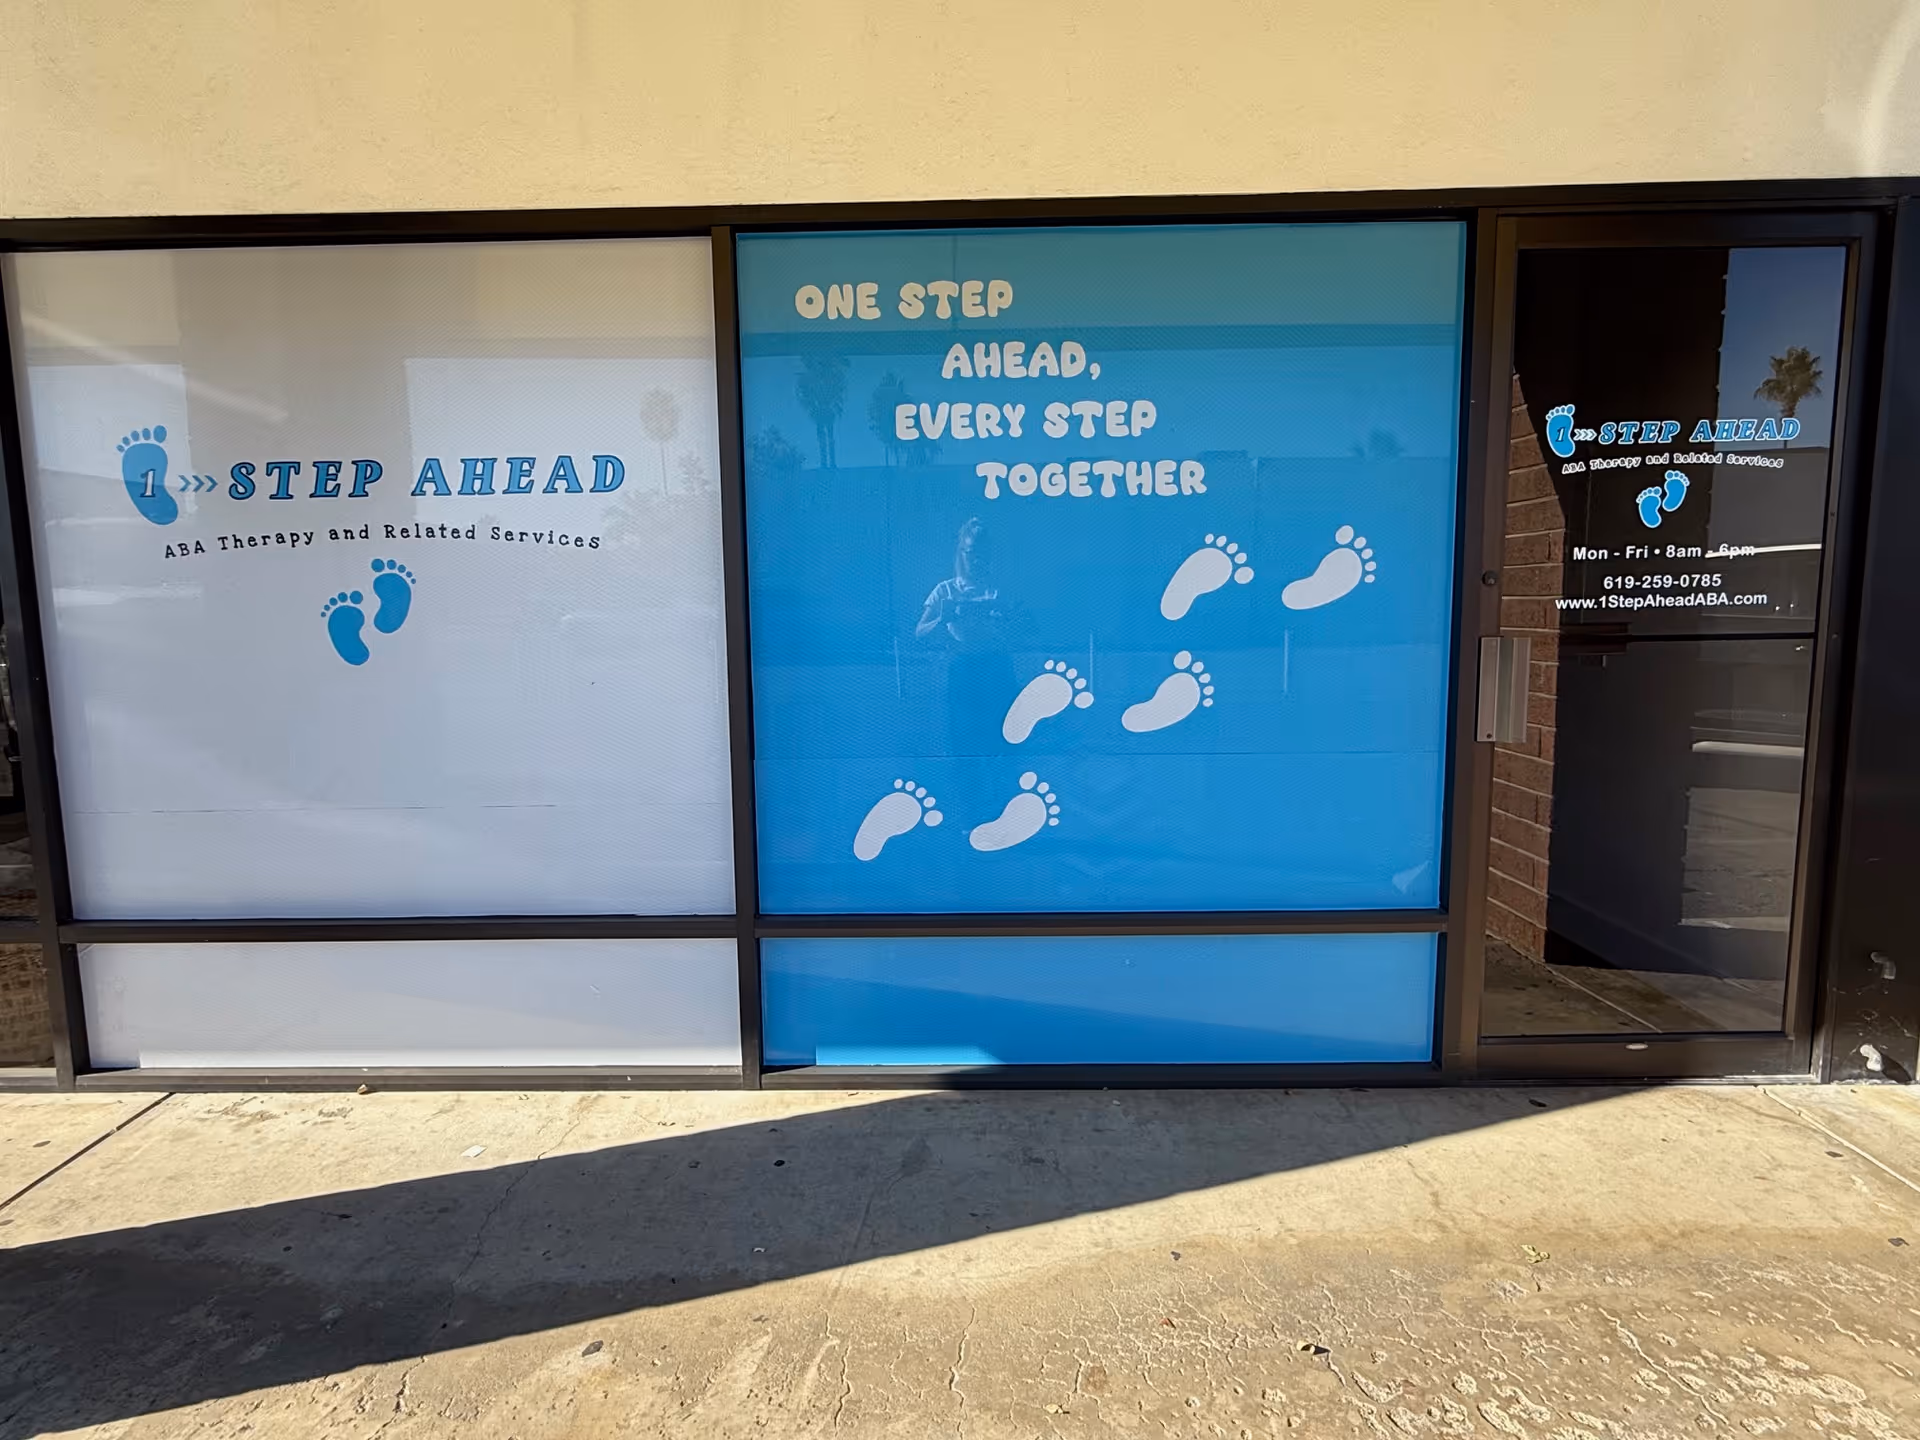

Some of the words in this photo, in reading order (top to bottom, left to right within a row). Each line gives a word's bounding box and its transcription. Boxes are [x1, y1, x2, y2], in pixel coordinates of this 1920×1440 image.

[795, 282, 880, 320] ONE
[898, 280, 1013, 319] STEP
[941, 341, 1101, 380] AHEAD,
[895, 402, 1026, 441] EVERY
[1043, 400, 1157, 438] STEP
[1555, 426, 1566, 443] 1
[1598, 421, 1681, 445] STEP
[1690, 418, 1801, 443] AHEAD
[139, 468, 158, 498] 1
[228, 459, 384, 501] STEP
[411, 454, 627, 497] AHEAD
[976, 460, 1207, 499] TOGETHER
[1562, 462, 1586, 474] ABA
[1590, 456, 1641, 470] Therapy
[1646, 453, 1669, 466] and
[1673, 452, 1722, 465] Related
[1726, 453, 1784, 469] Services
[164, 538, 207, 560] ABA
[218, 528, 315, 552] Therapy
[329, 523, 370, 542] and
[383, 522, 477, 541] Related
[490, 526, 602, 551] Services
[1573, 547, 1608, 561] Mon
[1626, 545, 1648, 560] Fri
[1665, 545, 1701, 559] 8am
[1719, 543, 1755, 560] 6pm
[1603, 573, 1722, 590] 619-259-0785
[1555, 592, 1768, 611] www.1StepAheadABA.com
